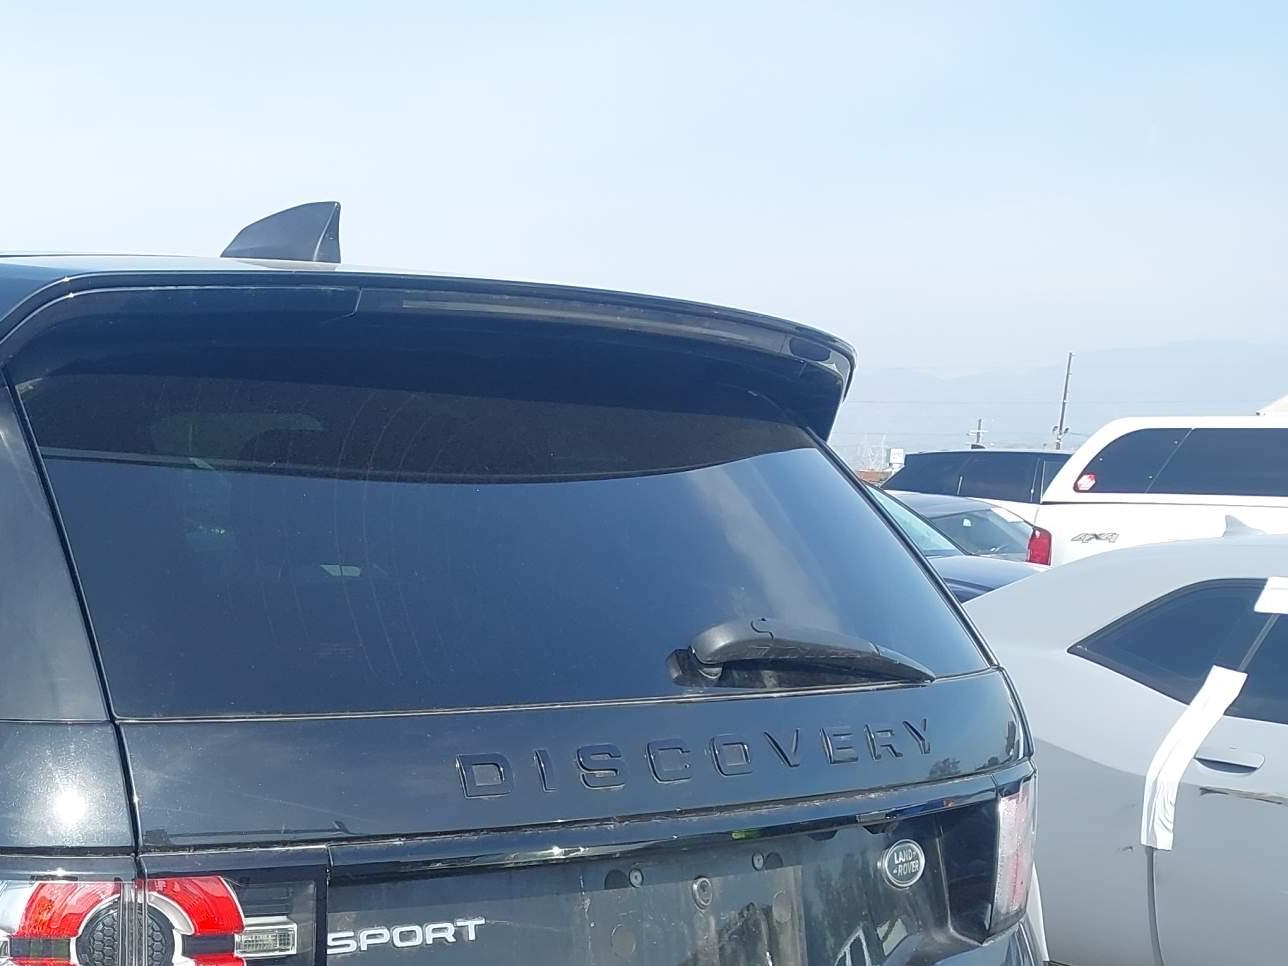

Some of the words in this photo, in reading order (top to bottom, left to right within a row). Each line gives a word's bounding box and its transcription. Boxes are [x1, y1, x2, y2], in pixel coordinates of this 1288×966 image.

[455, 717, 932, 800] DISCOVERY
[894, 849, 913, 864] LAND
[898, 860, 919, 876] ROVER
[327, 916, 486, 956] SPORT
